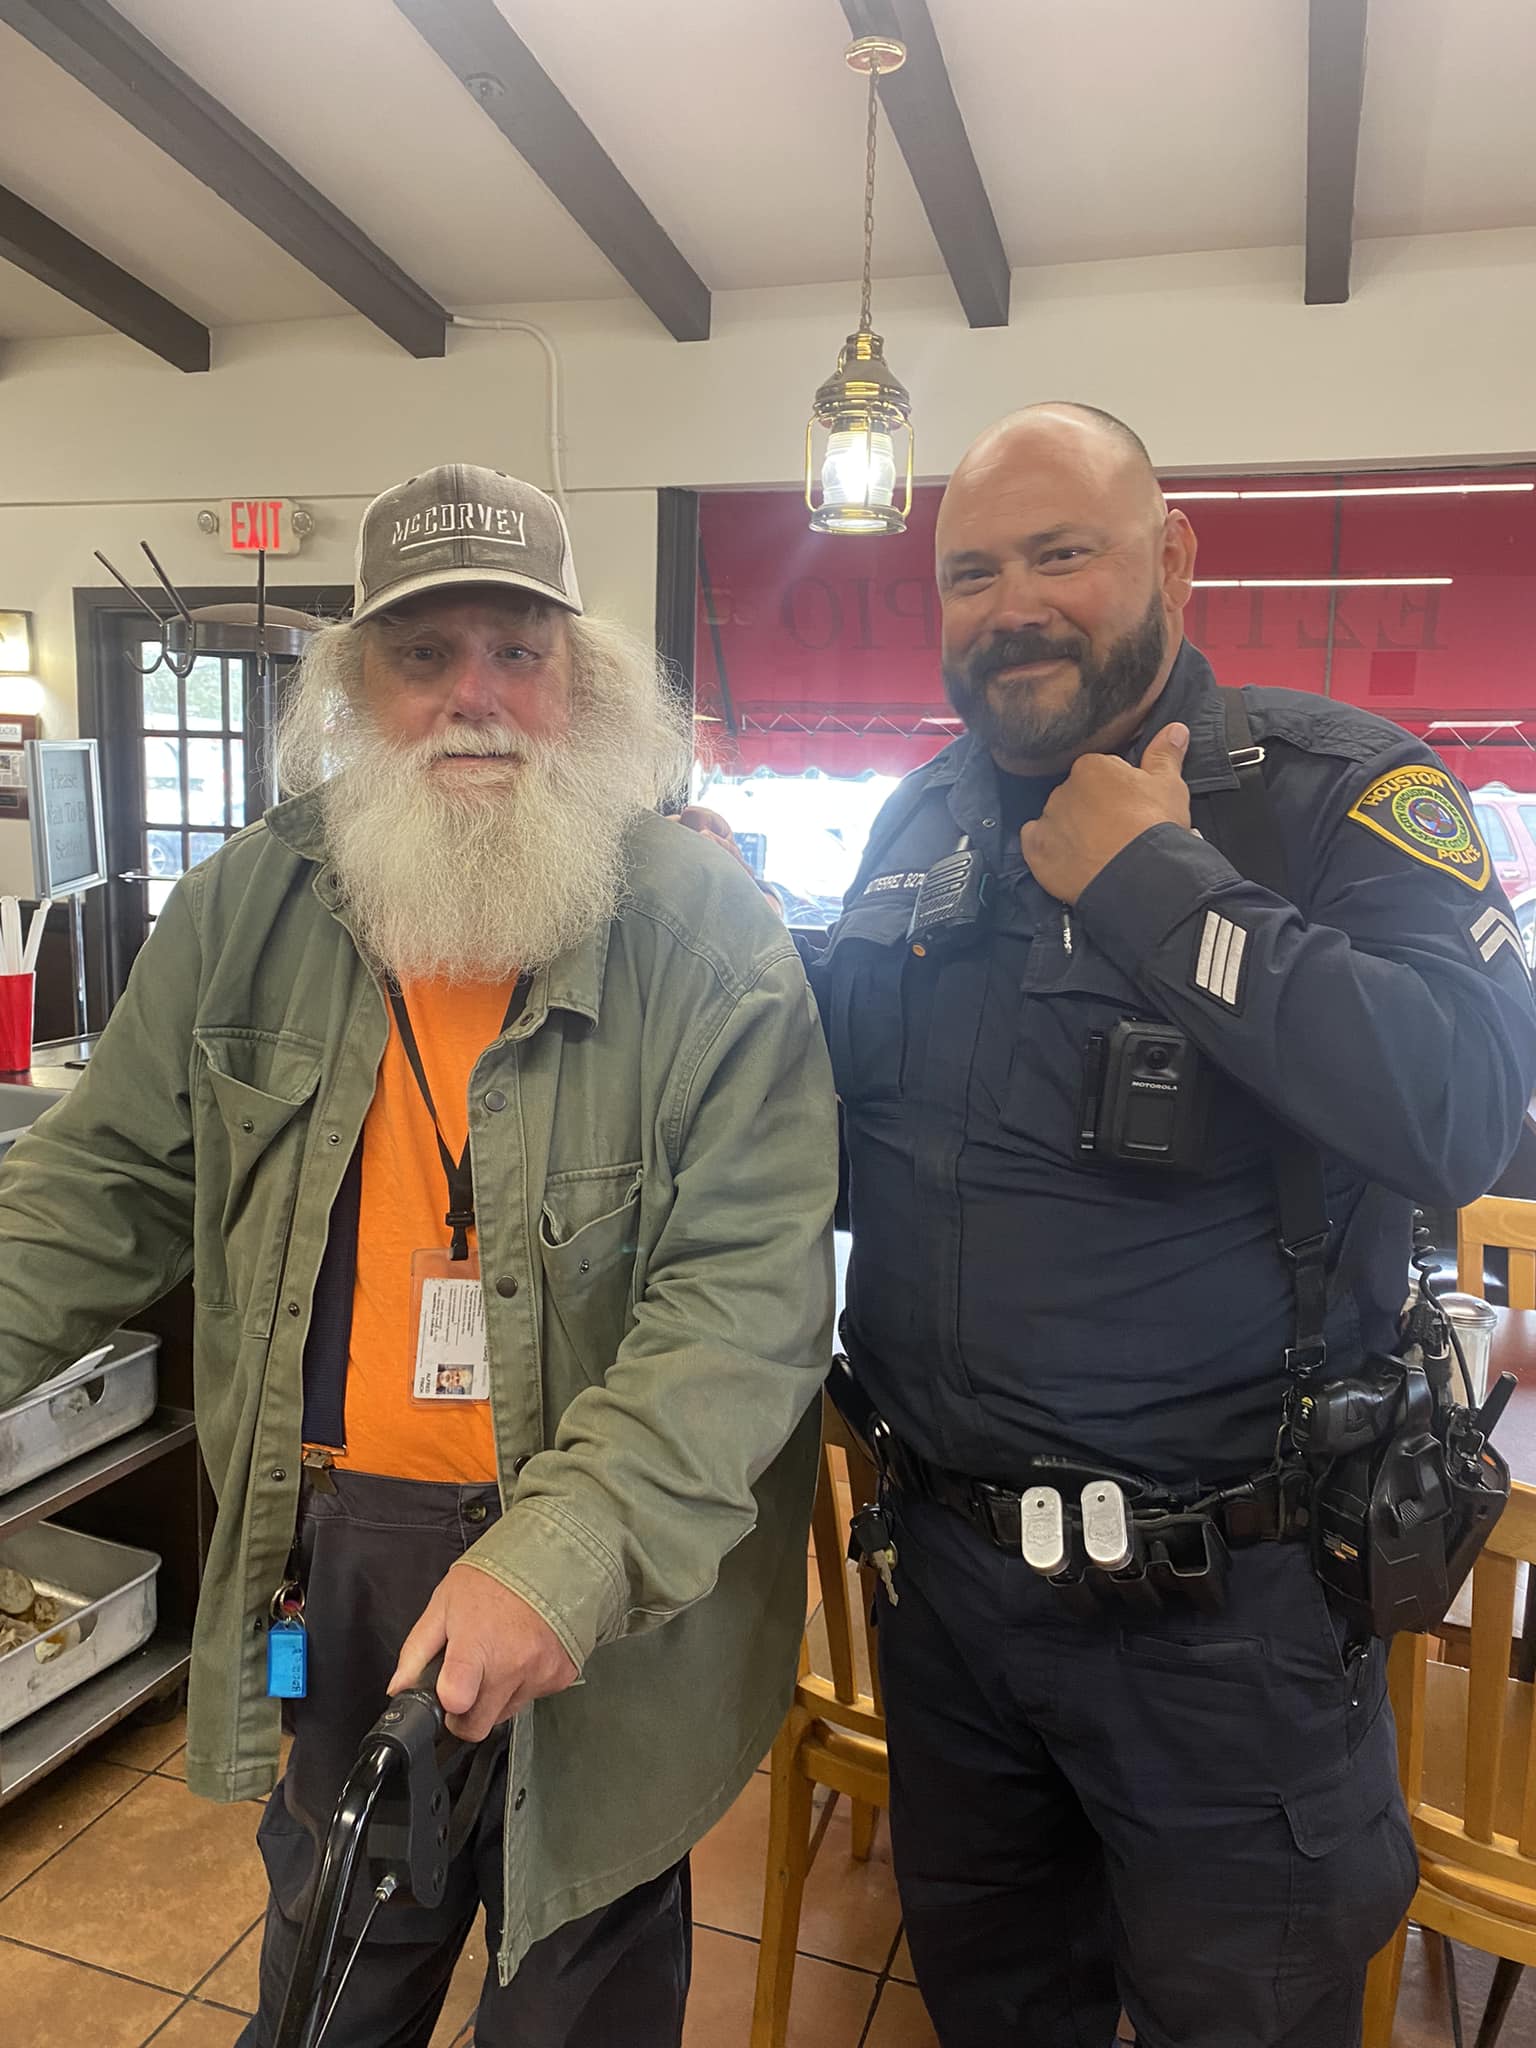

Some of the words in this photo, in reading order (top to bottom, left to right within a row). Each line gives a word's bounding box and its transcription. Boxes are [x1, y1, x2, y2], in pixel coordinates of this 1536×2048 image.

[231, 501, 283, 549] EXIT
[1363, 772, 1445, 807] HOUSTON
[1437, 845, 1481, 865] POLICE
[1131, 1080, 1178, 1091] MOTOROLA
